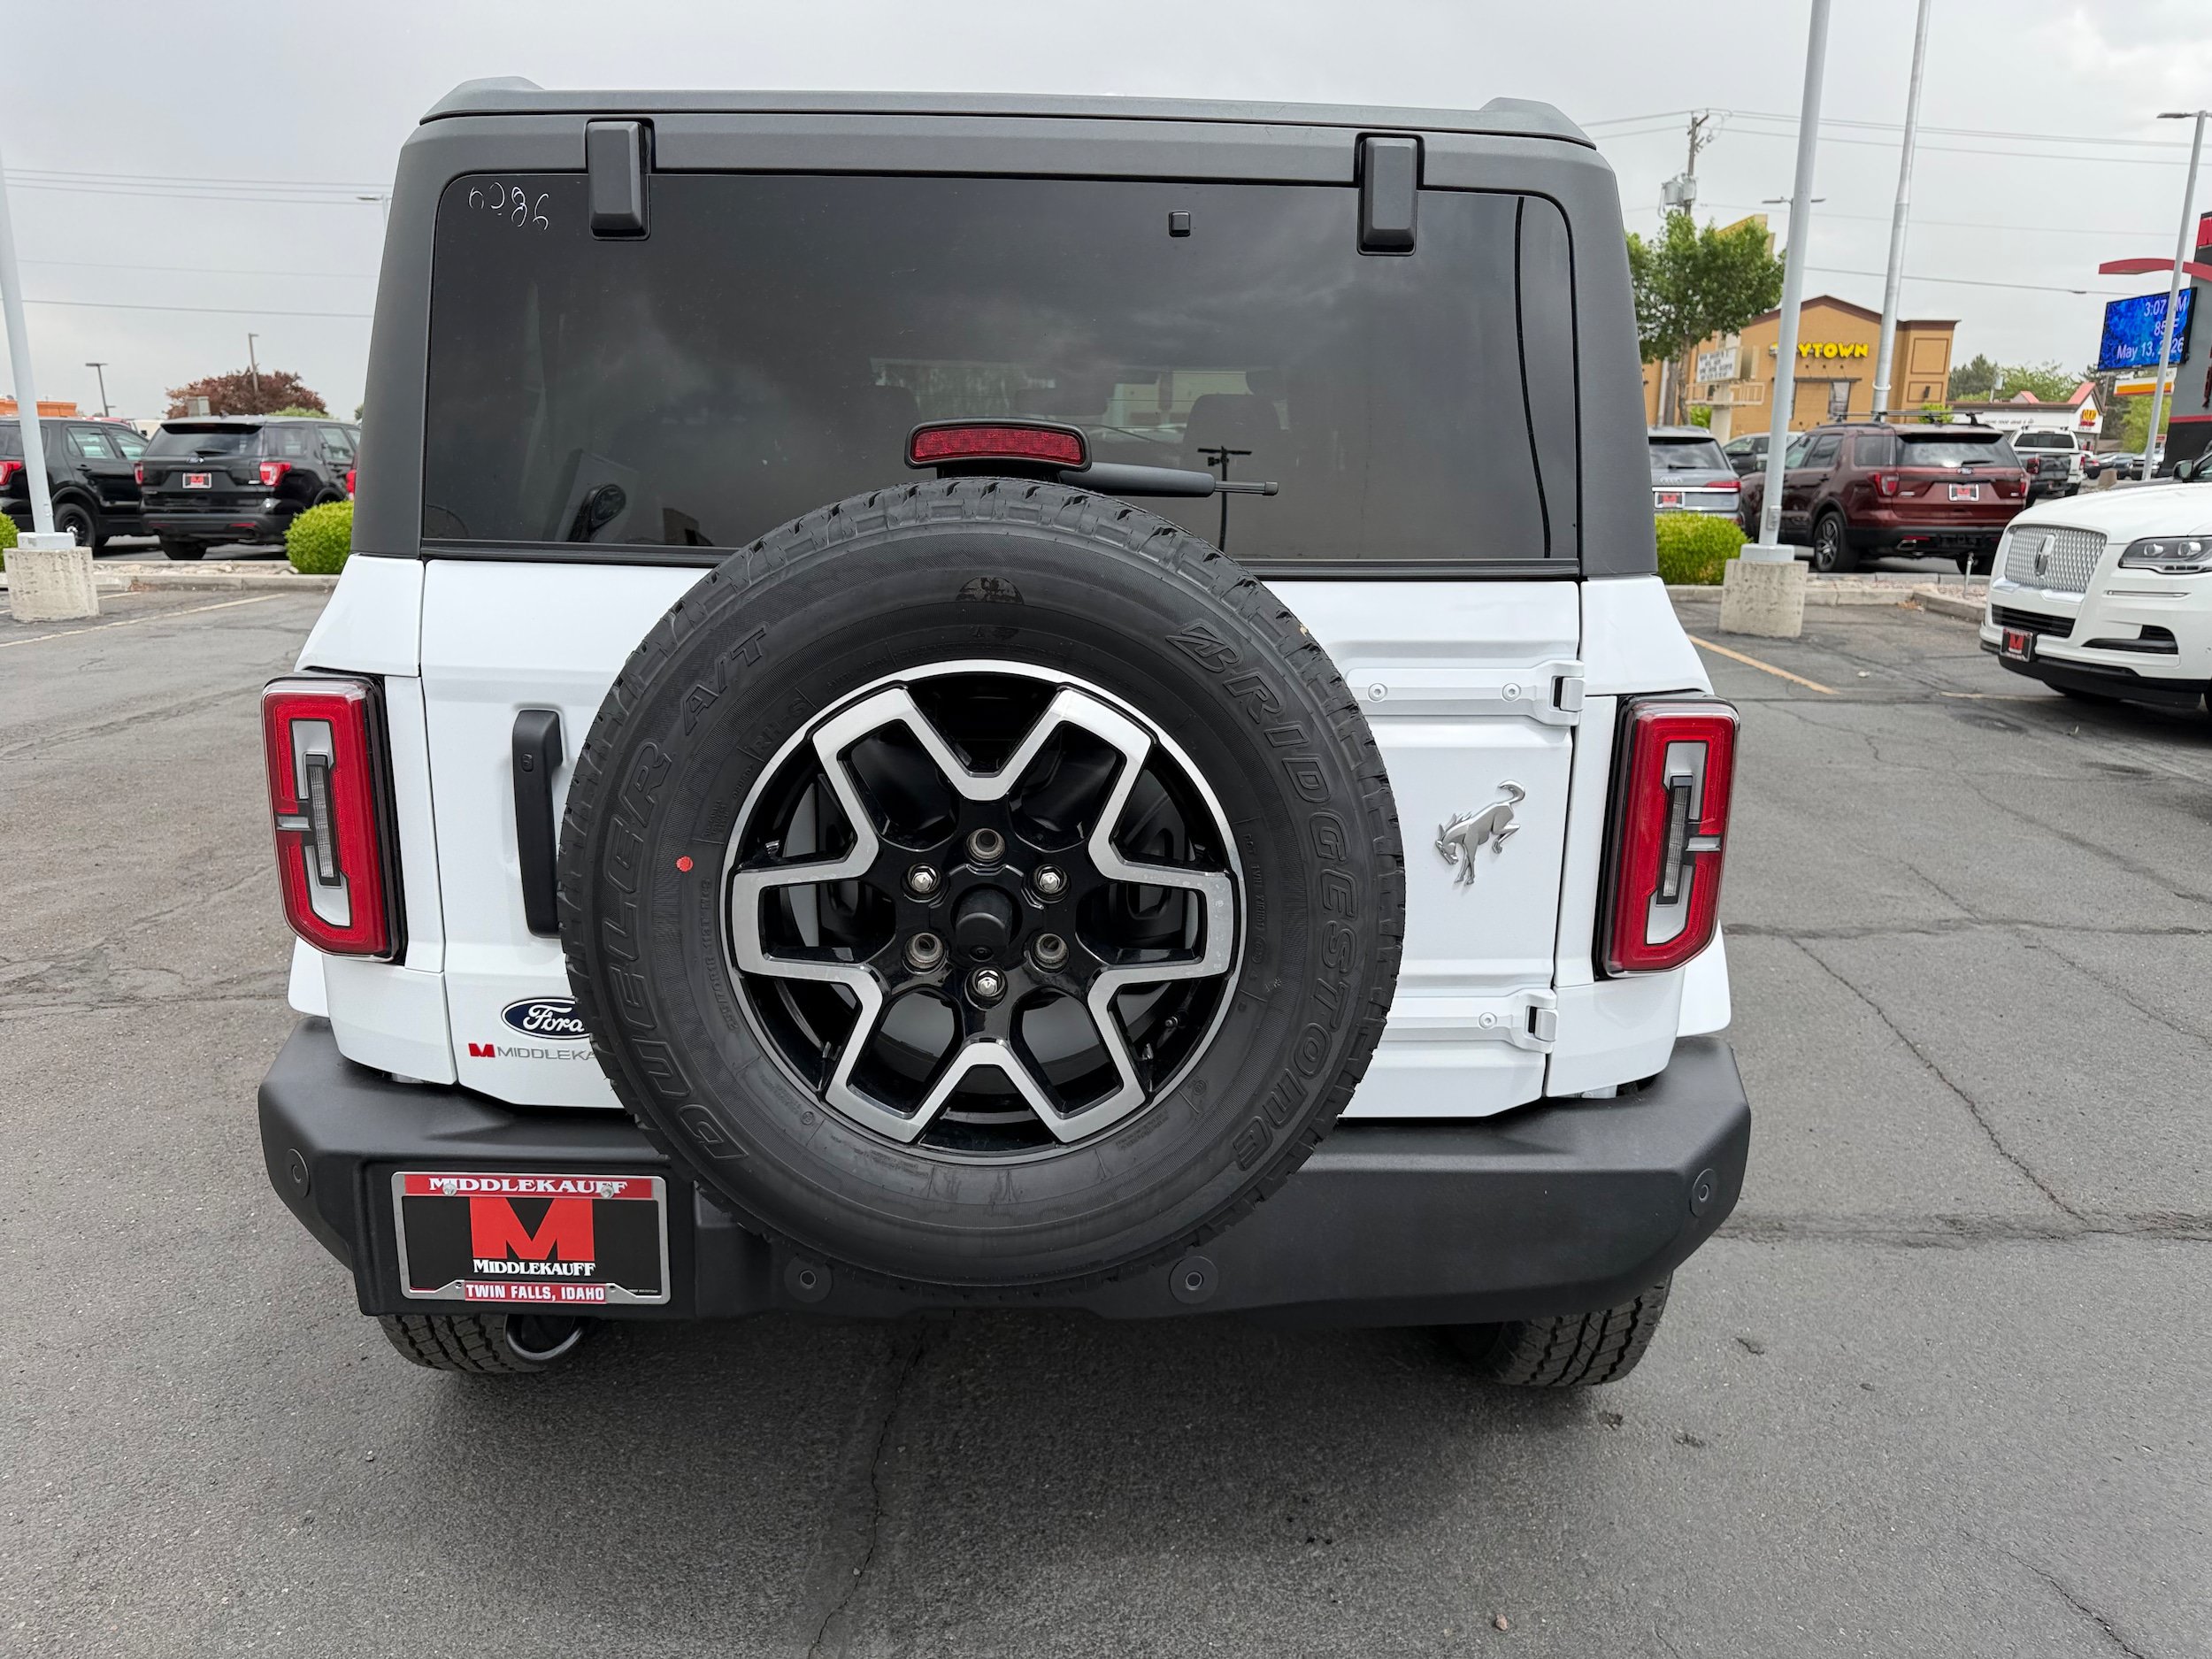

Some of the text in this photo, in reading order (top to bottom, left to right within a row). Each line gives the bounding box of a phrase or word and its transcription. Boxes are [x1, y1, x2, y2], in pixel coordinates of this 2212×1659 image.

[2144, 299, 2167, 317] 3:07
[1770, 342, 1870, 360] YTOWN
[2116, 337, 2185, 361] May 13, 226
[600, 622, 772, 1164] DUELER A/T
[1165, 622, 1359, 1172] BRIDGESTONE
[497, 1046, 595, 1061] MIDDLEKA
[429, 1178, 628, 1195] MIDDLEKAUFF
[469, 1196, 595, 1262] M
[472, 1259, 596, 1277] MIDDLEKAUFF
[465, 1284, 605, 1302] TWIN FALLS, IDAHO
